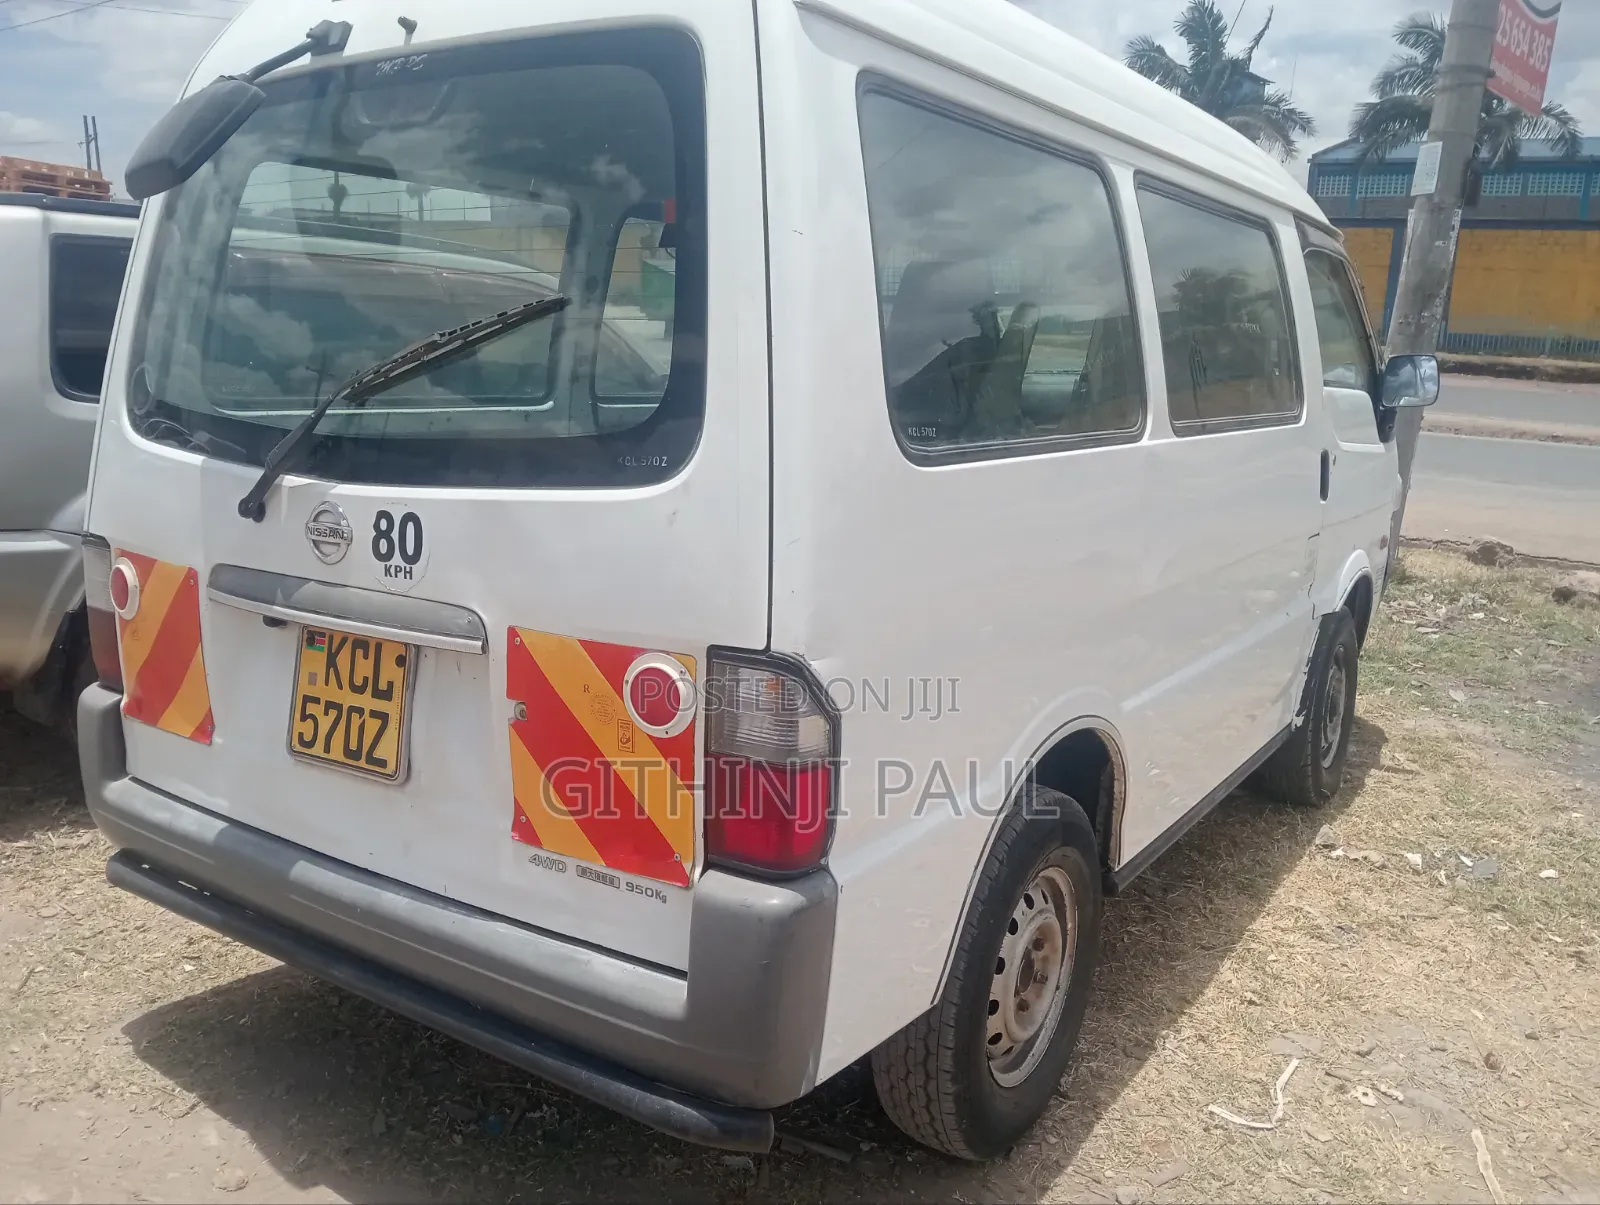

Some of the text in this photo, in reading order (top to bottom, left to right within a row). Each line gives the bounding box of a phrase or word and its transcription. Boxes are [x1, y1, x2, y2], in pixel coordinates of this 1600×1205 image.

[1511, 17, 1532, 60] 654
[1529, 29, 1552, 72] 385
[908, 426, 937, 437] KCL 570Z
[618, 456, 668, 467] KCL 570Z
[307, 526, 346, 540] NISSAN
[371, 509, 423, 565] 80
[384, 563, 413, 580] KPH
[324, 633, 394, 702] KCL
[583, 684, 590, 693] R
[297, 694, 390, 769] 570Z
[529, 854, 567, 873] 4WD
[625, 881, 667, 904] 950Kg
